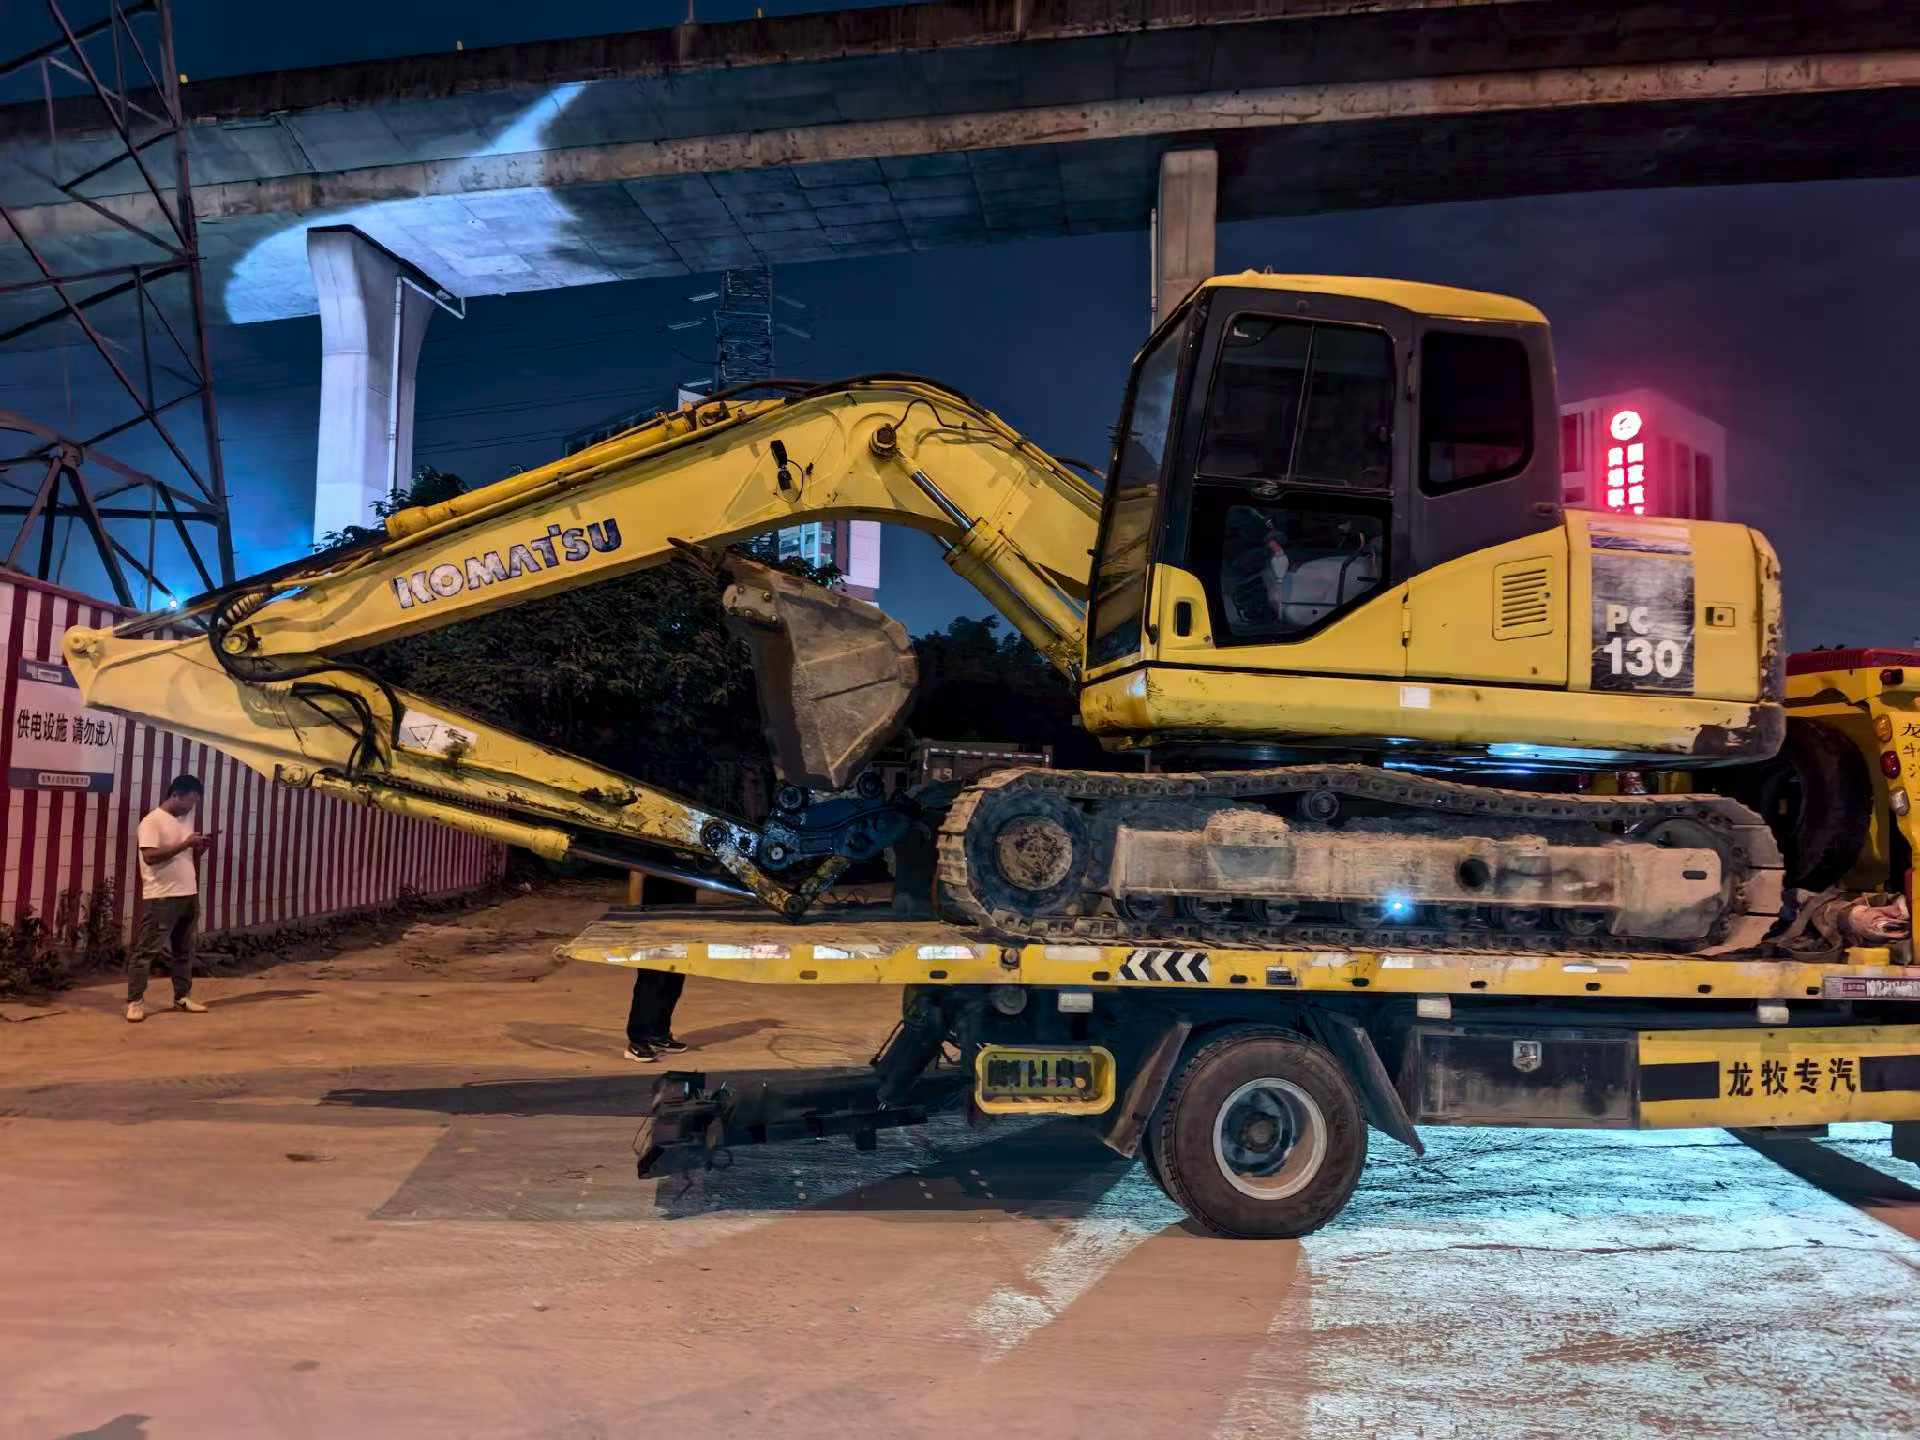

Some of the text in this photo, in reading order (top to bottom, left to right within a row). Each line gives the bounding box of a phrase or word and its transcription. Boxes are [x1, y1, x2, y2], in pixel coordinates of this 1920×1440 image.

[392, 518, 623, 609] KOMATSU
[1605, 604, 1650, 635] PC
[1602, 637, 1683, 678] 130
[16, 709, 115, 746] 供电设施 请勿进入
[1727, 1058, 1856, 1097] 龙牧专汽
